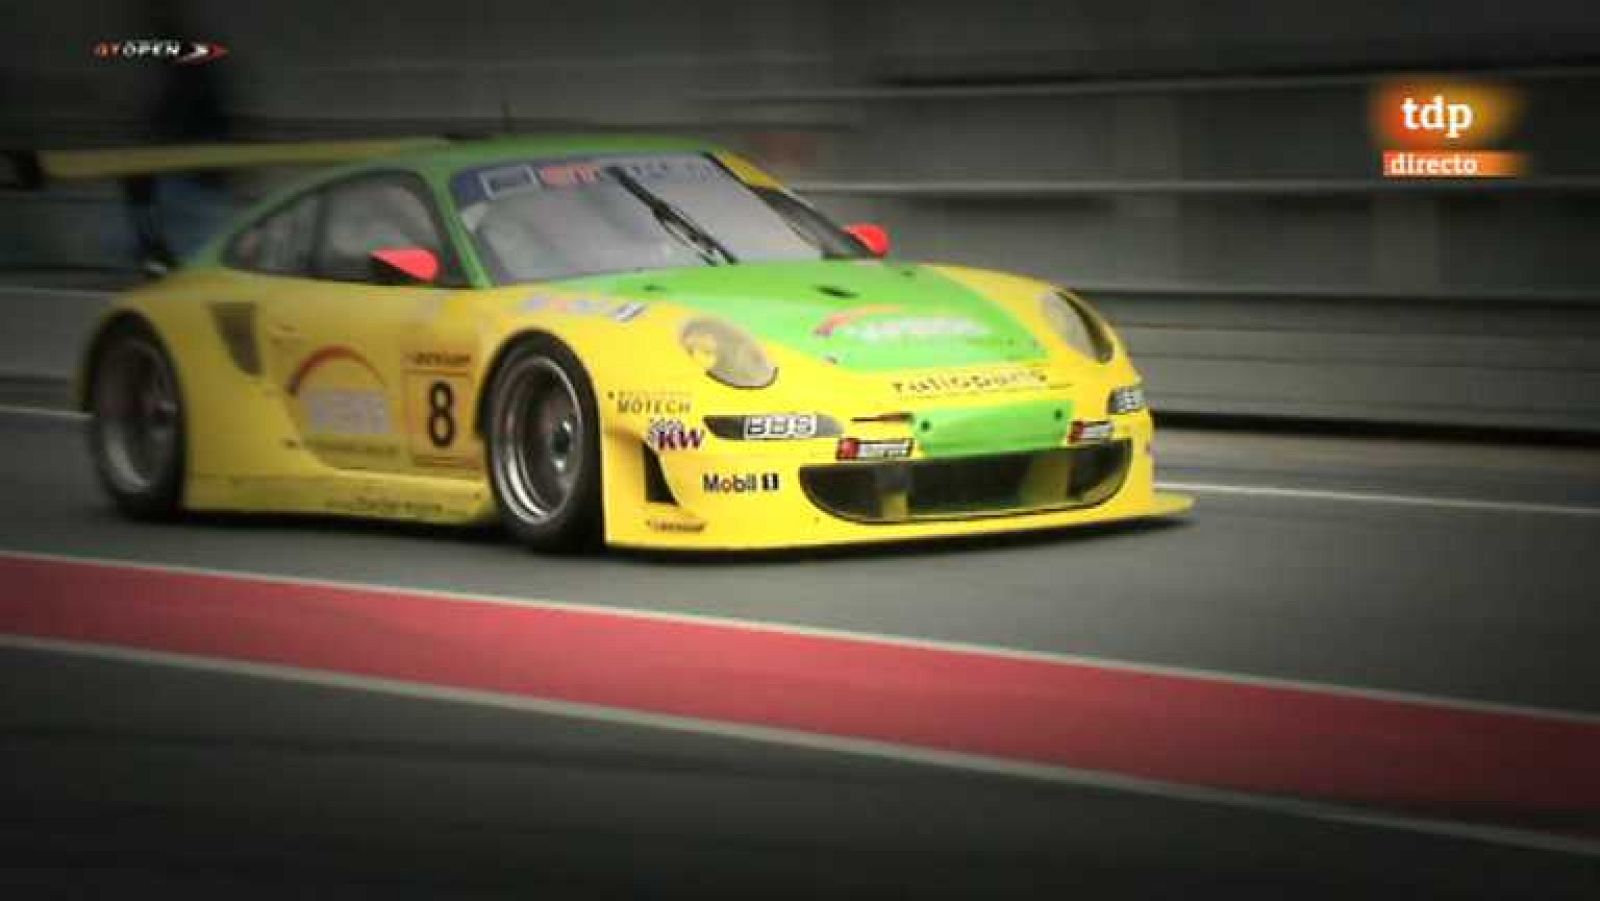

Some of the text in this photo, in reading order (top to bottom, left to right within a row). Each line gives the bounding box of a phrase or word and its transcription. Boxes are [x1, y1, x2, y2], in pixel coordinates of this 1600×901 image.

[427, 380, 456, 447] 8
[657, 431, 705, 451] KW
[703, 473, 757, 492] Mobil
